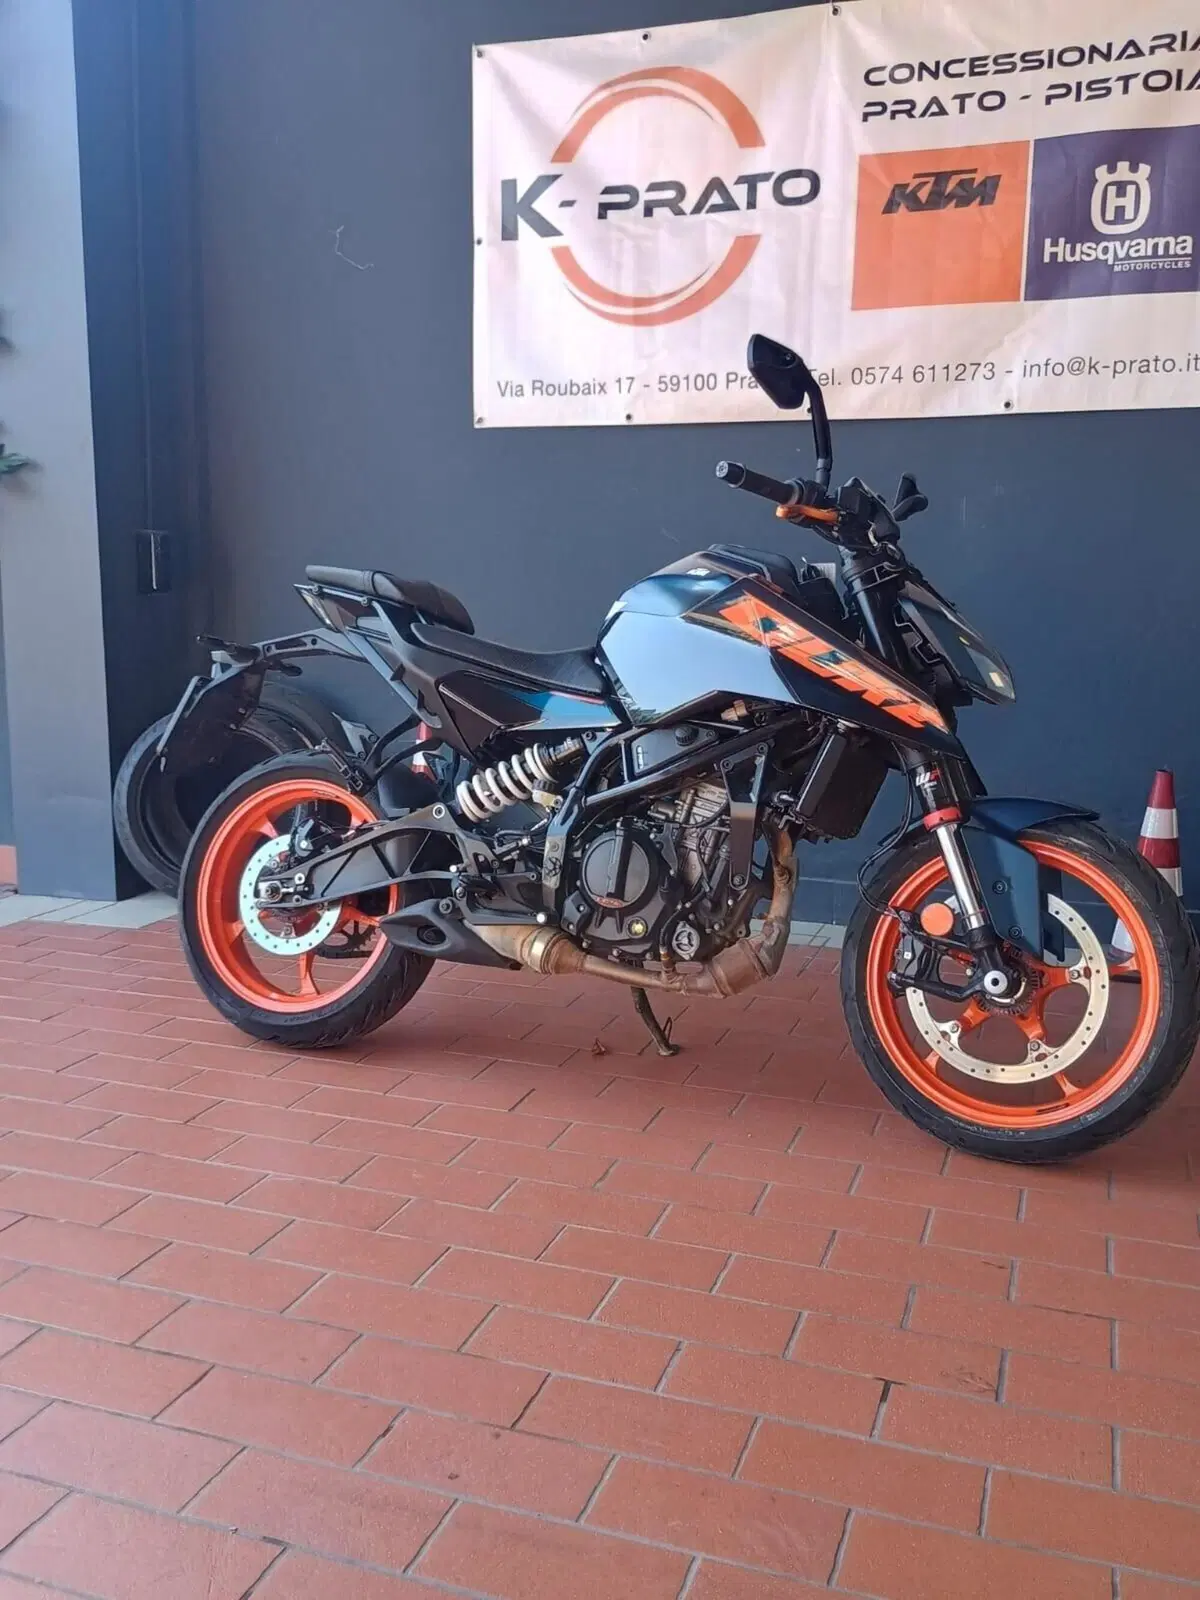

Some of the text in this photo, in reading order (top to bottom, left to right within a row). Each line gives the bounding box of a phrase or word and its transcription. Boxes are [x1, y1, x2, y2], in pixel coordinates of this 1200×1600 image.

[862, 90, 1006, 122] PRATO
[597, 168, 821, 220] PRATO
[881, 168, 1002, 215] KTM
[1043, 235, 1193, 265] Husqvarna
[1113, 260, 1192, 272] MOTORCYCLES
[497, 380, 525, 398] Via
[532, 377, 607, 396] Roubaix
[615, 376, 634, 394] 17
[657, 373, 718, 393] 59100
[726, 371, 760, 391] Pra
[850, 365, 904, 386] 0574
[912, 361, 996, 384] 611273
[1023, 352, 1200, 380] info@k-prato.it
